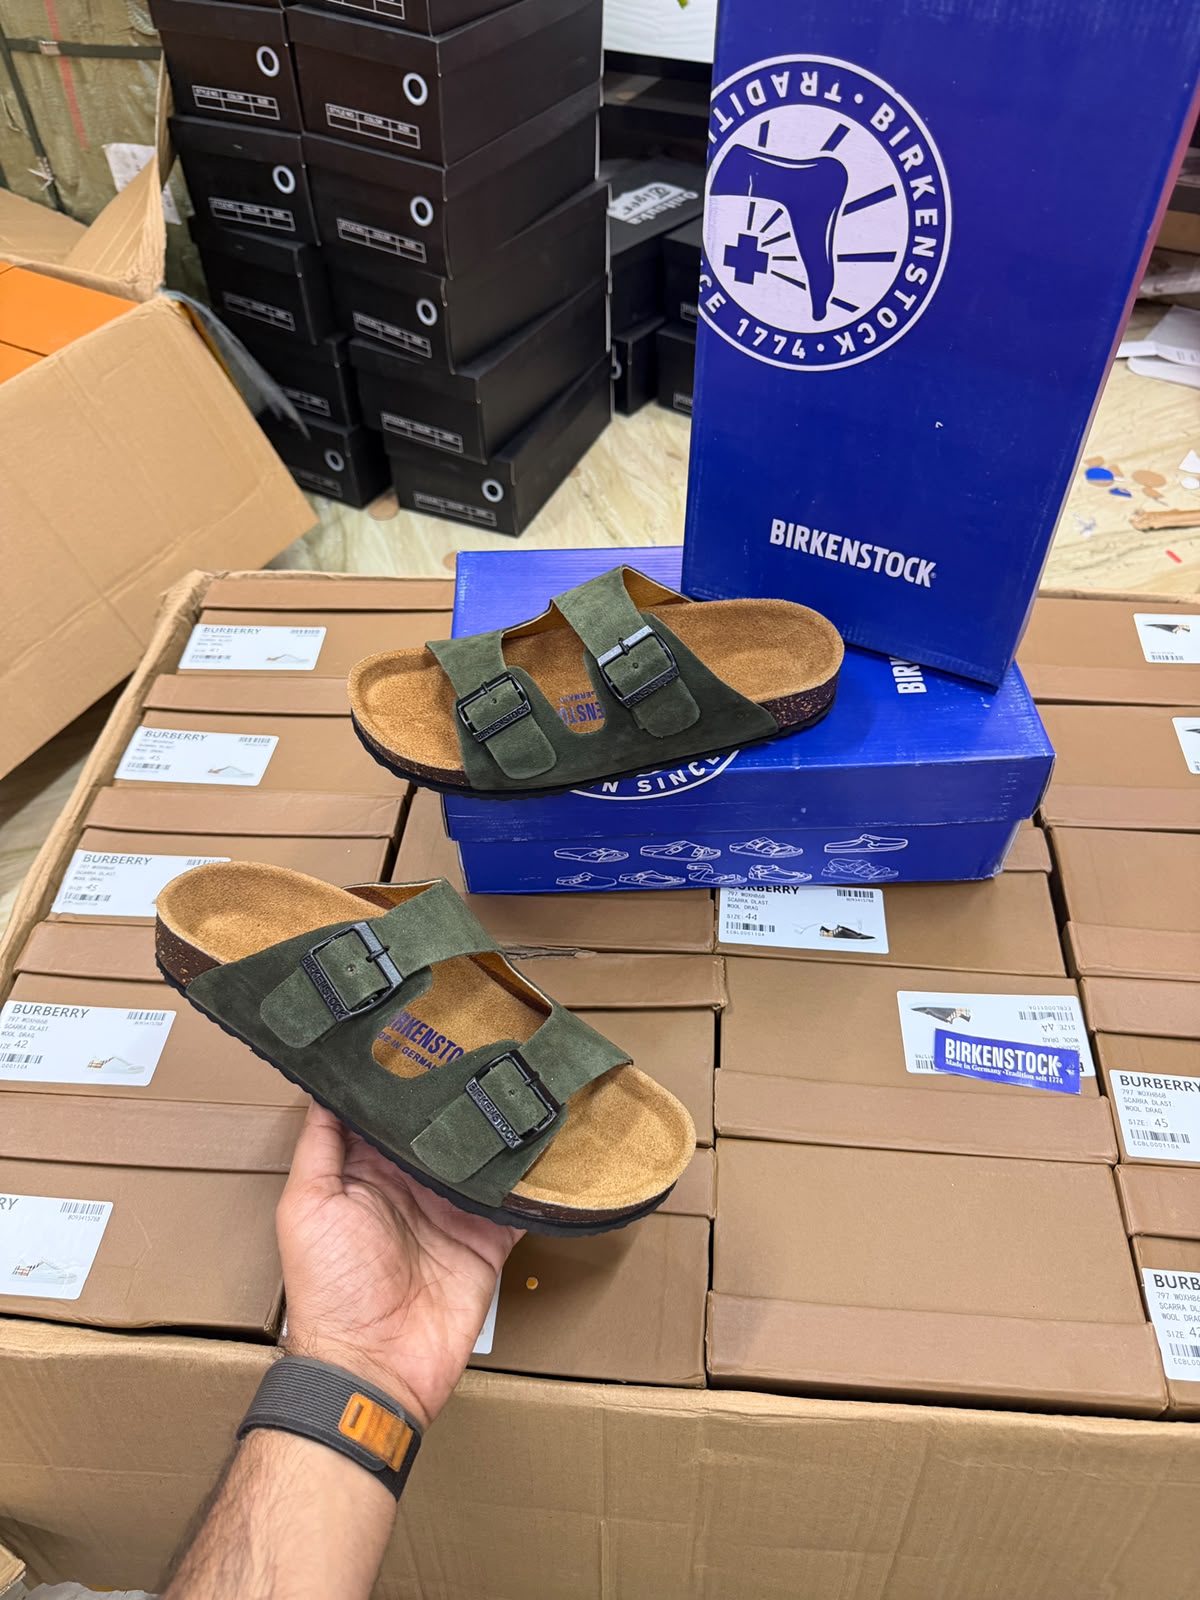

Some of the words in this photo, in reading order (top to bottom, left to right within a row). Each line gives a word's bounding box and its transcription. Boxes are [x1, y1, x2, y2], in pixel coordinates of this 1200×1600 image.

[833, 102, 938, 355] BIRKENSTOCK
[736, 318, 806, 359] 1774
[203, 627, 262, 636] BURBERRY
[144, 730, 208, 742] BURBERRY
[83, 854, 152, 866] BURBERRY
[727, 884, 799, 895] RBERRY
[745, 912, 757, 920] 44
[12, 1003, 90, 1019] BURBERRY
[387, 1010, 464, 1064] RKENSTO
[14, 1039, 29, 1049] 42
[945, 1059, 962, 1069] Made
[972, 1065, 1001, 1076] Germany
[1120, 1075, 1200, 1093] BURBERRY
[468, 1081, 521, 1148] BIRKENSTOCK
[1154, 1118, 1168, 1128] 45
[1156, 1291, 1169, 1300] 797
[1161, 1312, 1180, 1322] WOOL
